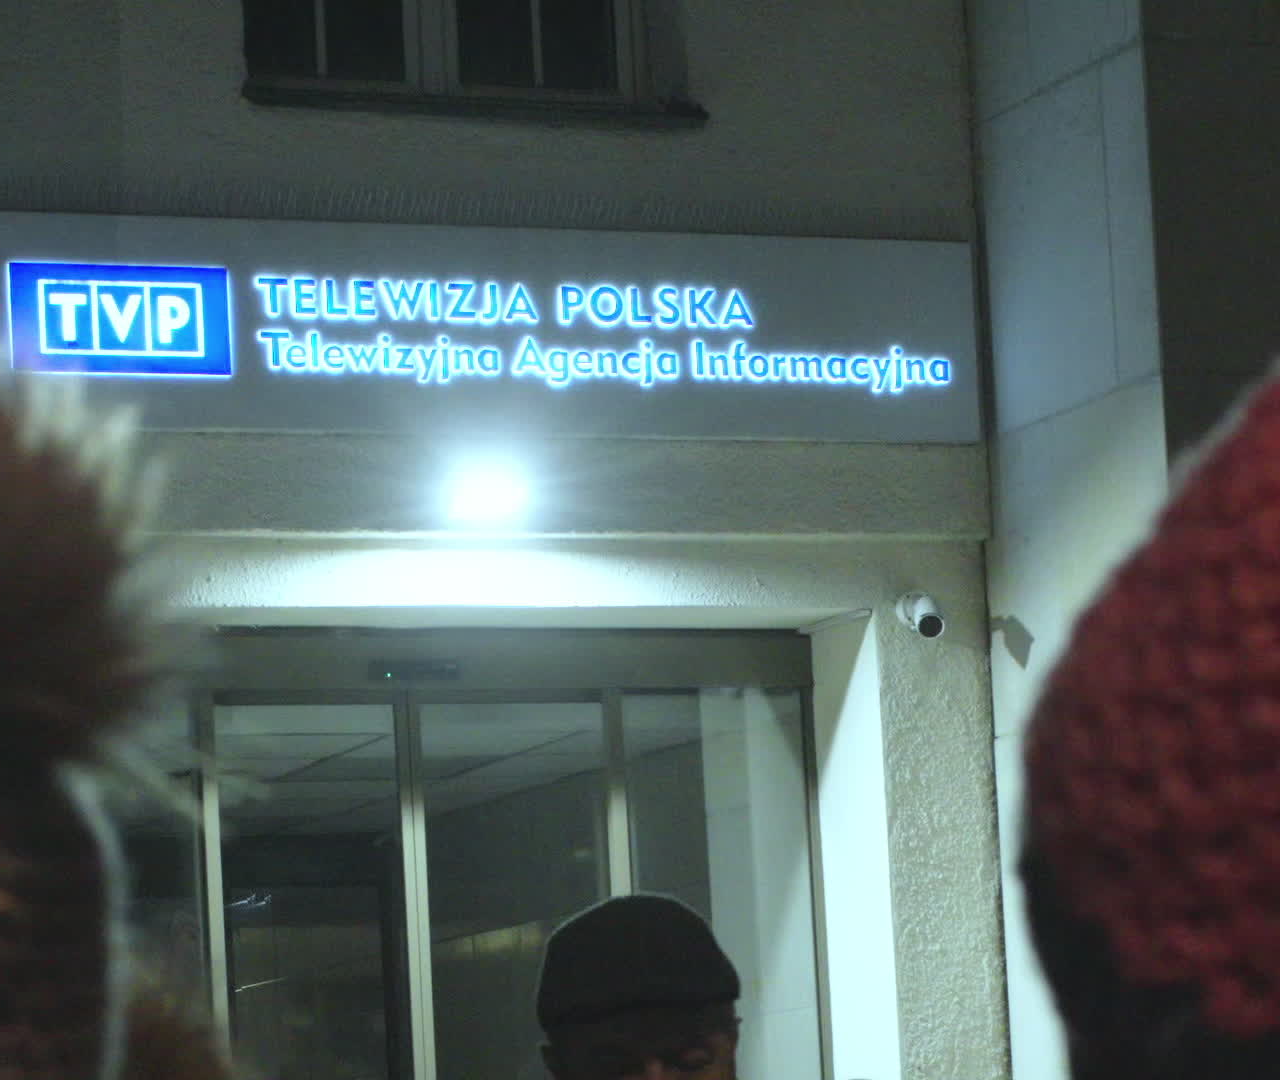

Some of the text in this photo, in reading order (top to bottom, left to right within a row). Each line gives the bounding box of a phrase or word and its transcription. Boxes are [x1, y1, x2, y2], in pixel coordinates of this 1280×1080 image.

[48, 292, 191, 343] TVP
[258, 277, 755, 329] TELEWIZJA POLSKA
[260, 331, 952, 393] Telewizyjna Agencja Informacyjna
